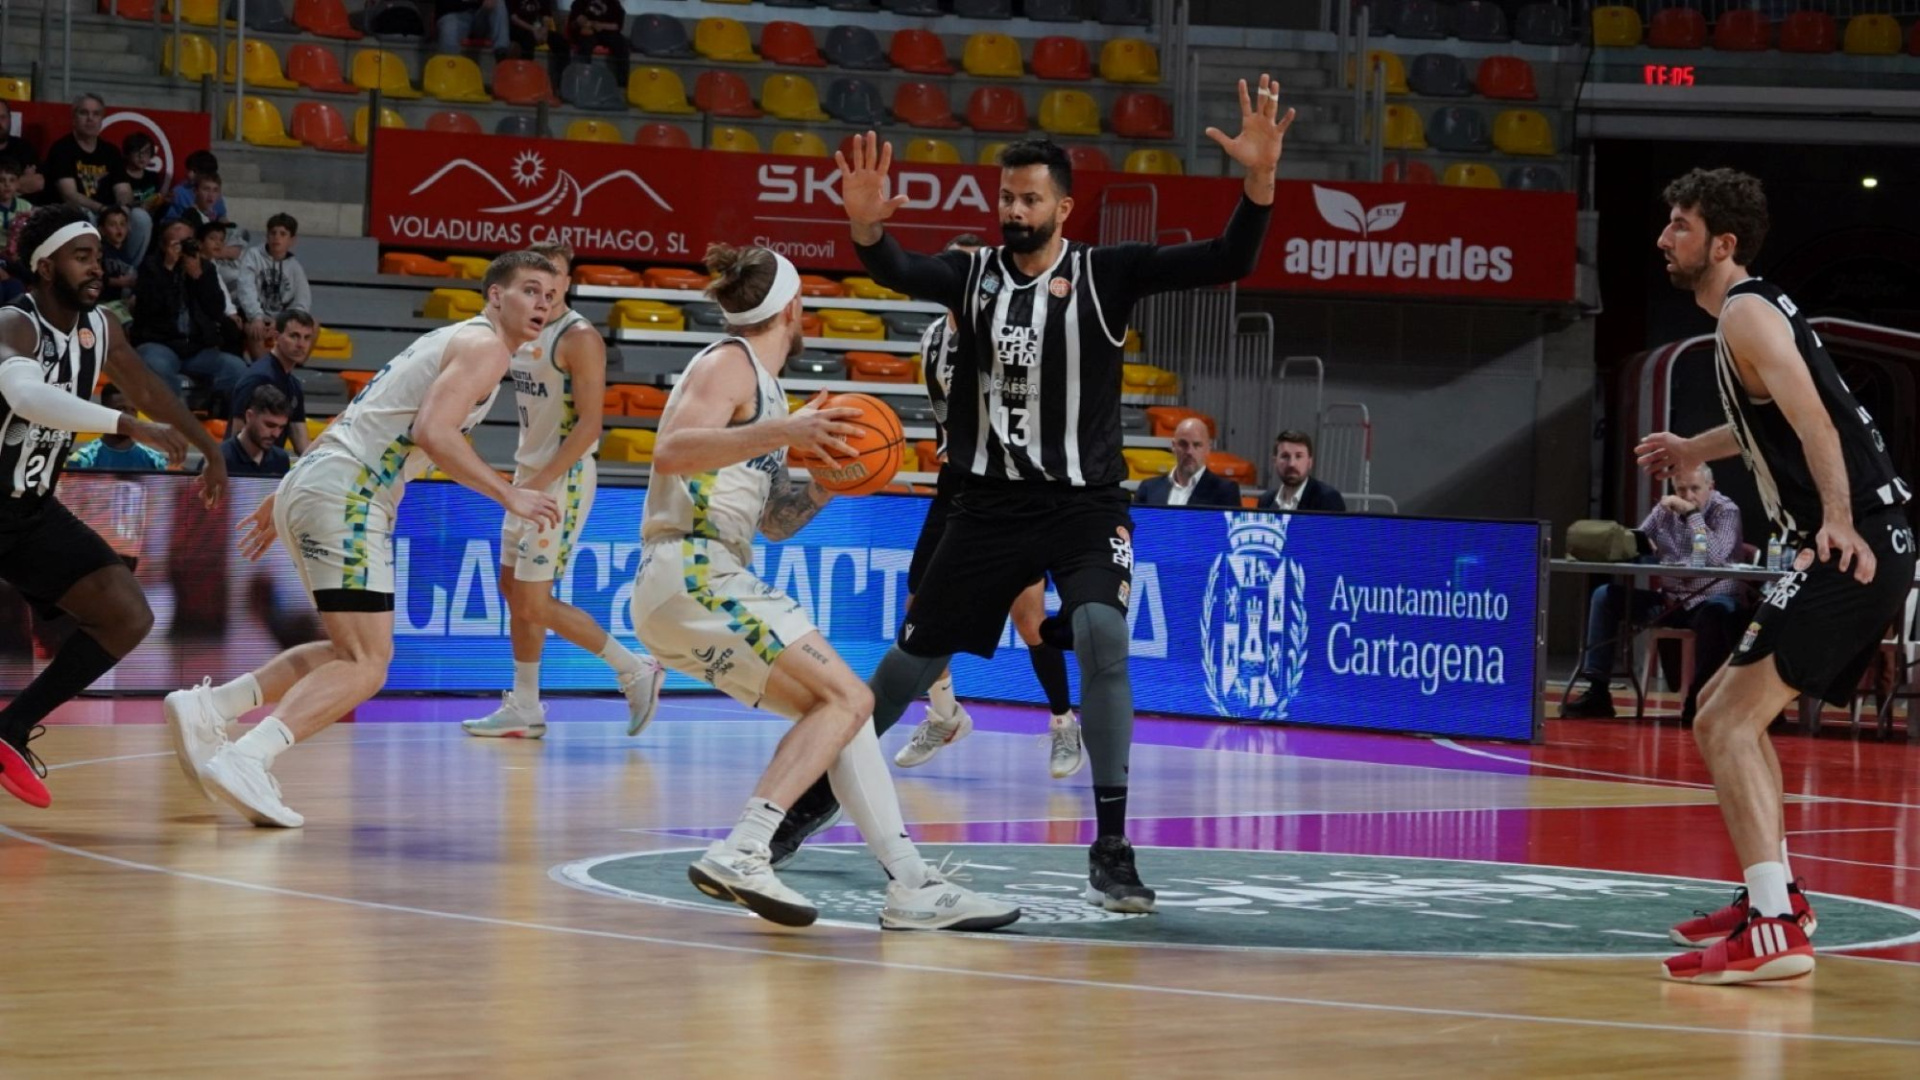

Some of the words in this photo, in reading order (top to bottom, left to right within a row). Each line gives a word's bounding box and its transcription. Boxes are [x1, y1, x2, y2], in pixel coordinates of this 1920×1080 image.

[389, 214, 522, 244] VOLADURAS
[528, 224, 659, 256] CARTHAGO,
[666, 232, 691, 254] SL
[753, 235, 835, 258] Skomovil
[1284, 236, 1513, 283] agriverdes
[994, 380, 1038, 395] CAESA
[997, 405, 1032, 448] 13
[26, 454, 46, 488] 2
[1330, 574, 1509, 622] Ayuntamiento
[1327, 622, 1505, 695] Cartagena
